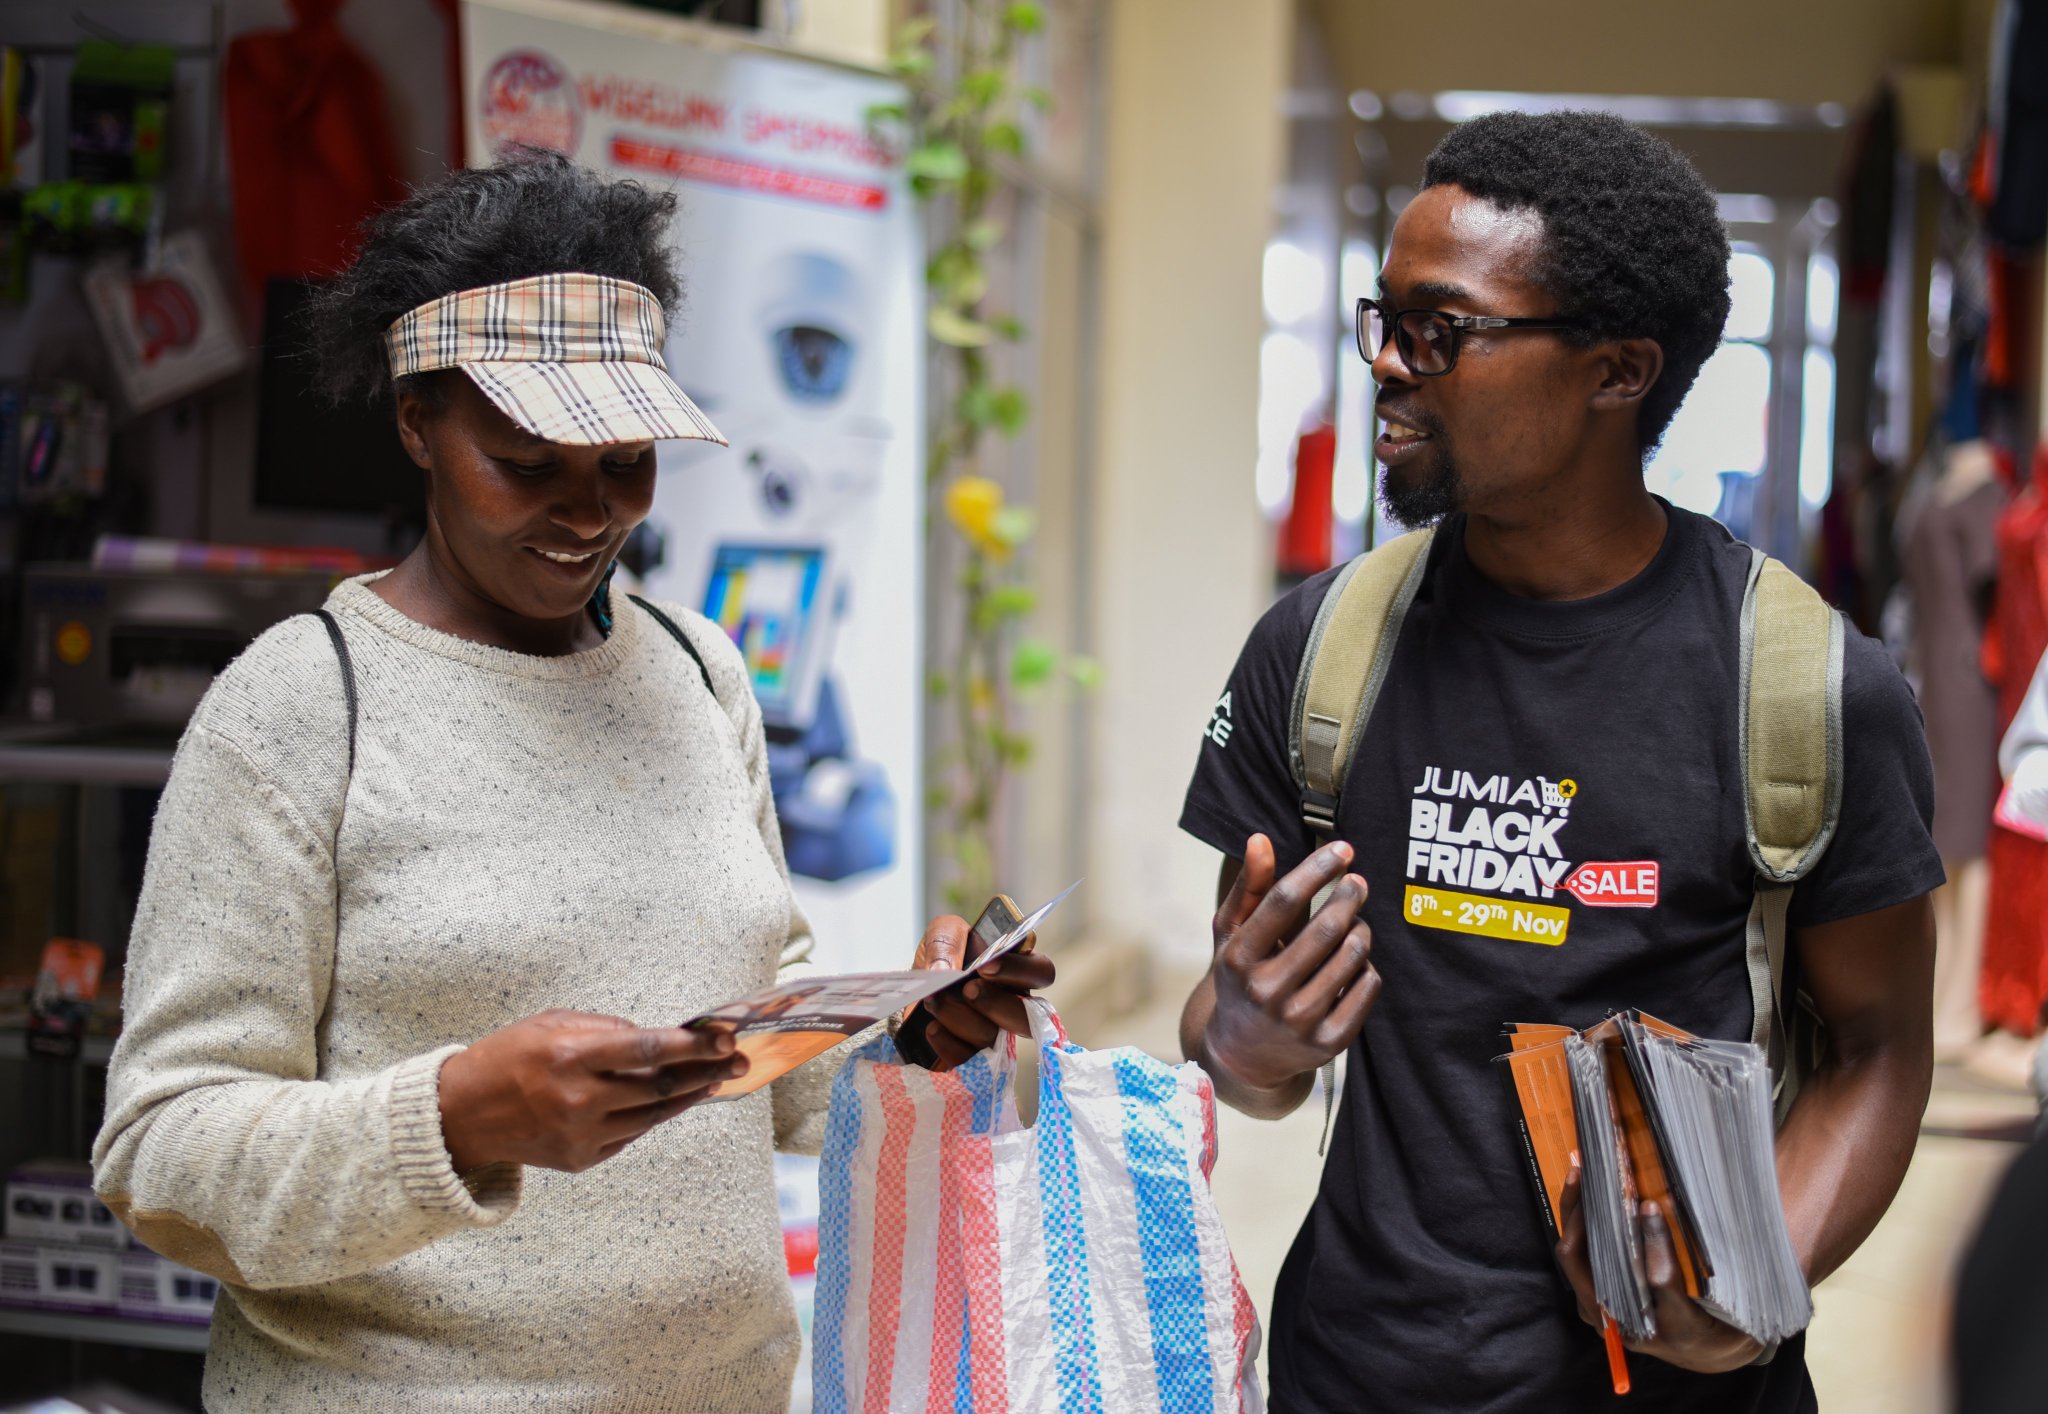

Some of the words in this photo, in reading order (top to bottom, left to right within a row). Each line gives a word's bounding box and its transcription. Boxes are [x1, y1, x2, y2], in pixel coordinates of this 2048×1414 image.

[1413, 766, 1541, 808] JUMIA
[1409, 798, 1568, 858] BLACK
[1406, 839, 1571, 898] FRIDAY
[1578, 870, 1655, 895] SALE
[1512, 910, 1565, 937] Nov
